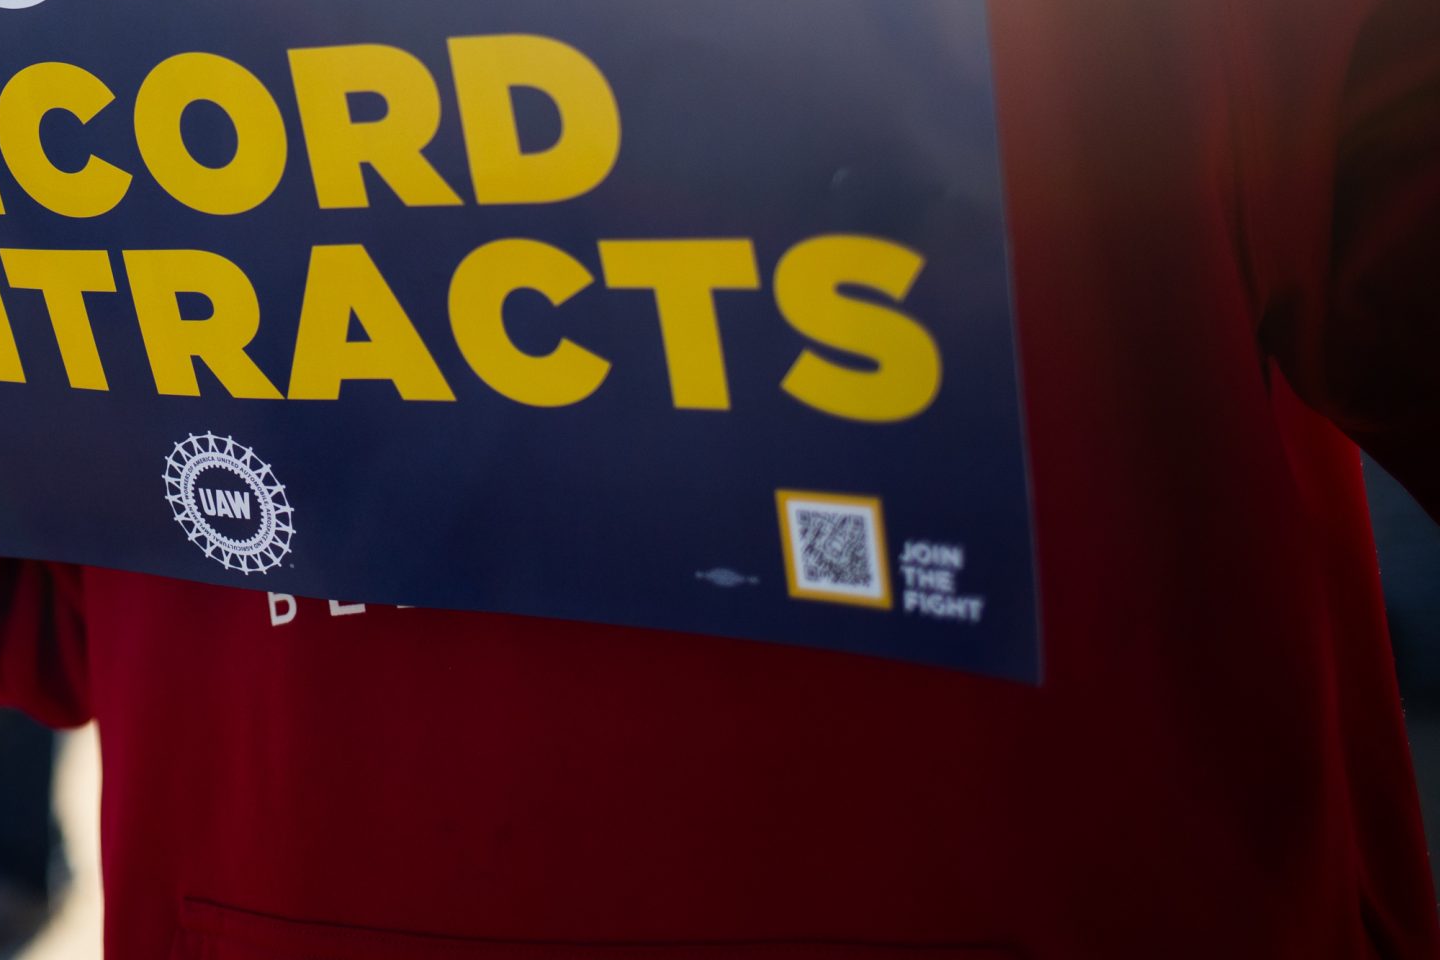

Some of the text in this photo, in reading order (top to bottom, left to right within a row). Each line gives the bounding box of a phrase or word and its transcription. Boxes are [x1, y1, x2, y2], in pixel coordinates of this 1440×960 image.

[193, 456, 215, 468] AMERICA
[216, 456, 239, 469] UNITED
[198, 487, 251, 520] UAW
[900, 541, 963, 568] JOIN
[901, 566, 955, 593] THE
[903, 591, 983, 622] FIGHT
